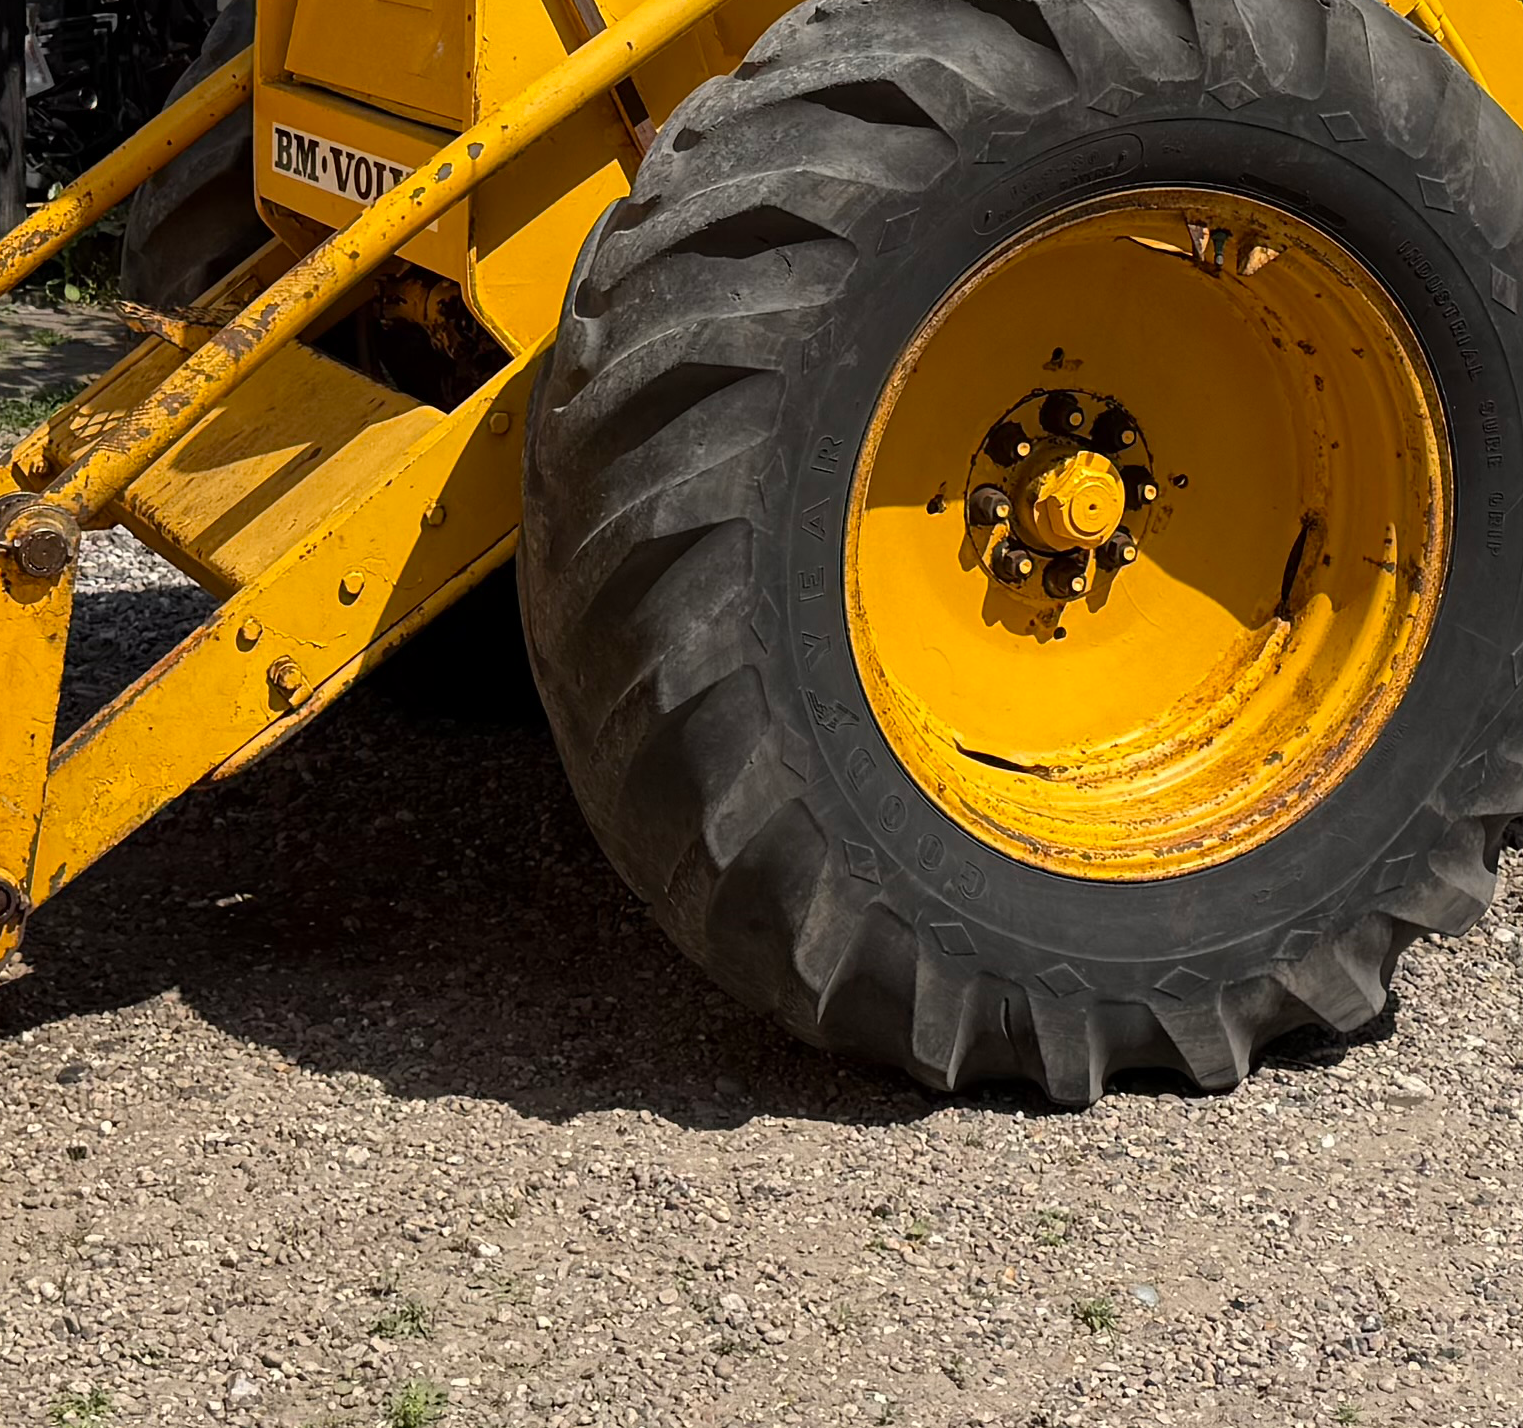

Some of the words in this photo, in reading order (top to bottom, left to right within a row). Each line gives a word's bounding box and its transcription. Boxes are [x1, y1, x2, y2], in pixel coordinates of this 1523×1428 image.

[1395, 238, 1485, 383] INDUSTRIAL
[1479, 399, 1504, 470] SURE
[1486, 490, 1505, 558] GRIP
